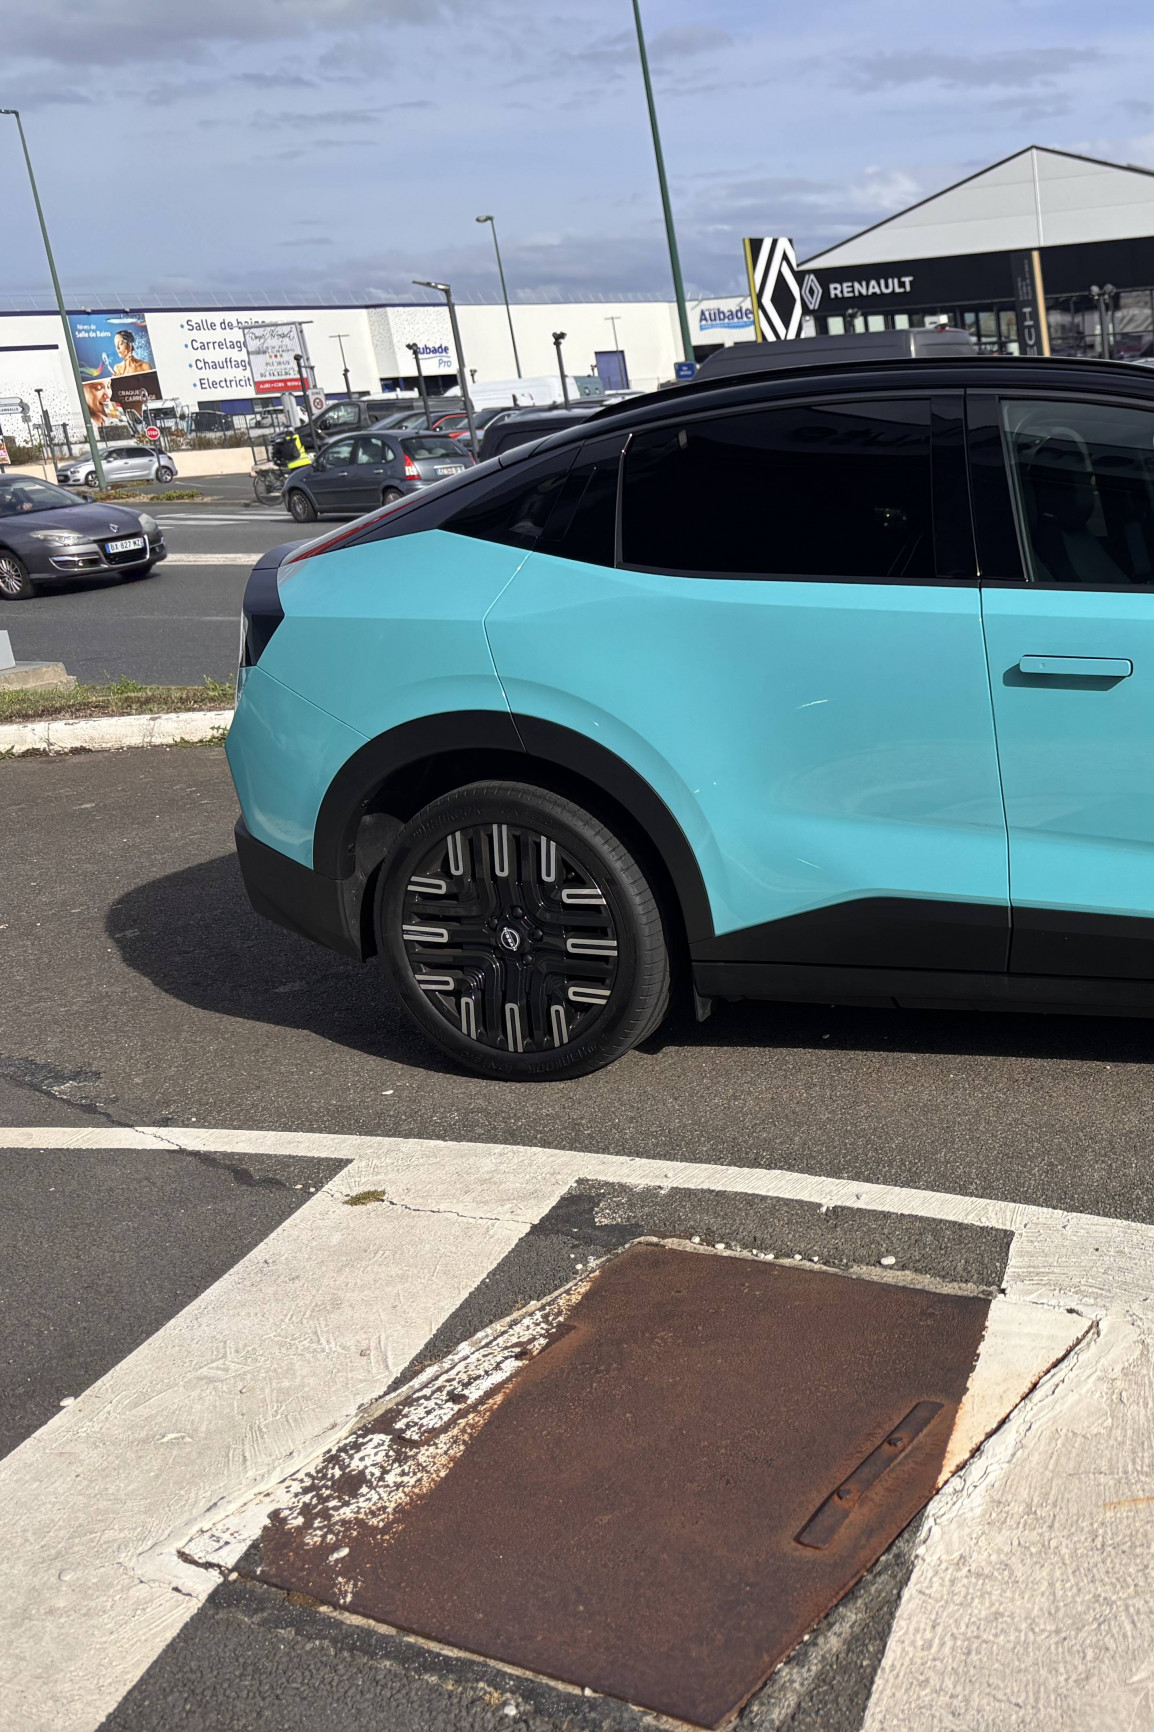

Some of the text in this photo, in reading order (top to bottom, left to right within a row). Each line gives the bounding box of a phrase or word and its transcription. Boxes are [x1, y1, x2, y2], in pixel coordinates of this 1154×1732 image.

[829, 276, 914, 299] RENAULT
[700, 306, 754, 323] Aubade
[186, 319, 217, 331] Salle
[220, 319, 234, 330] de
[416, 344, 449, 355] ubade
[438, 359, 452, 368] Pro
